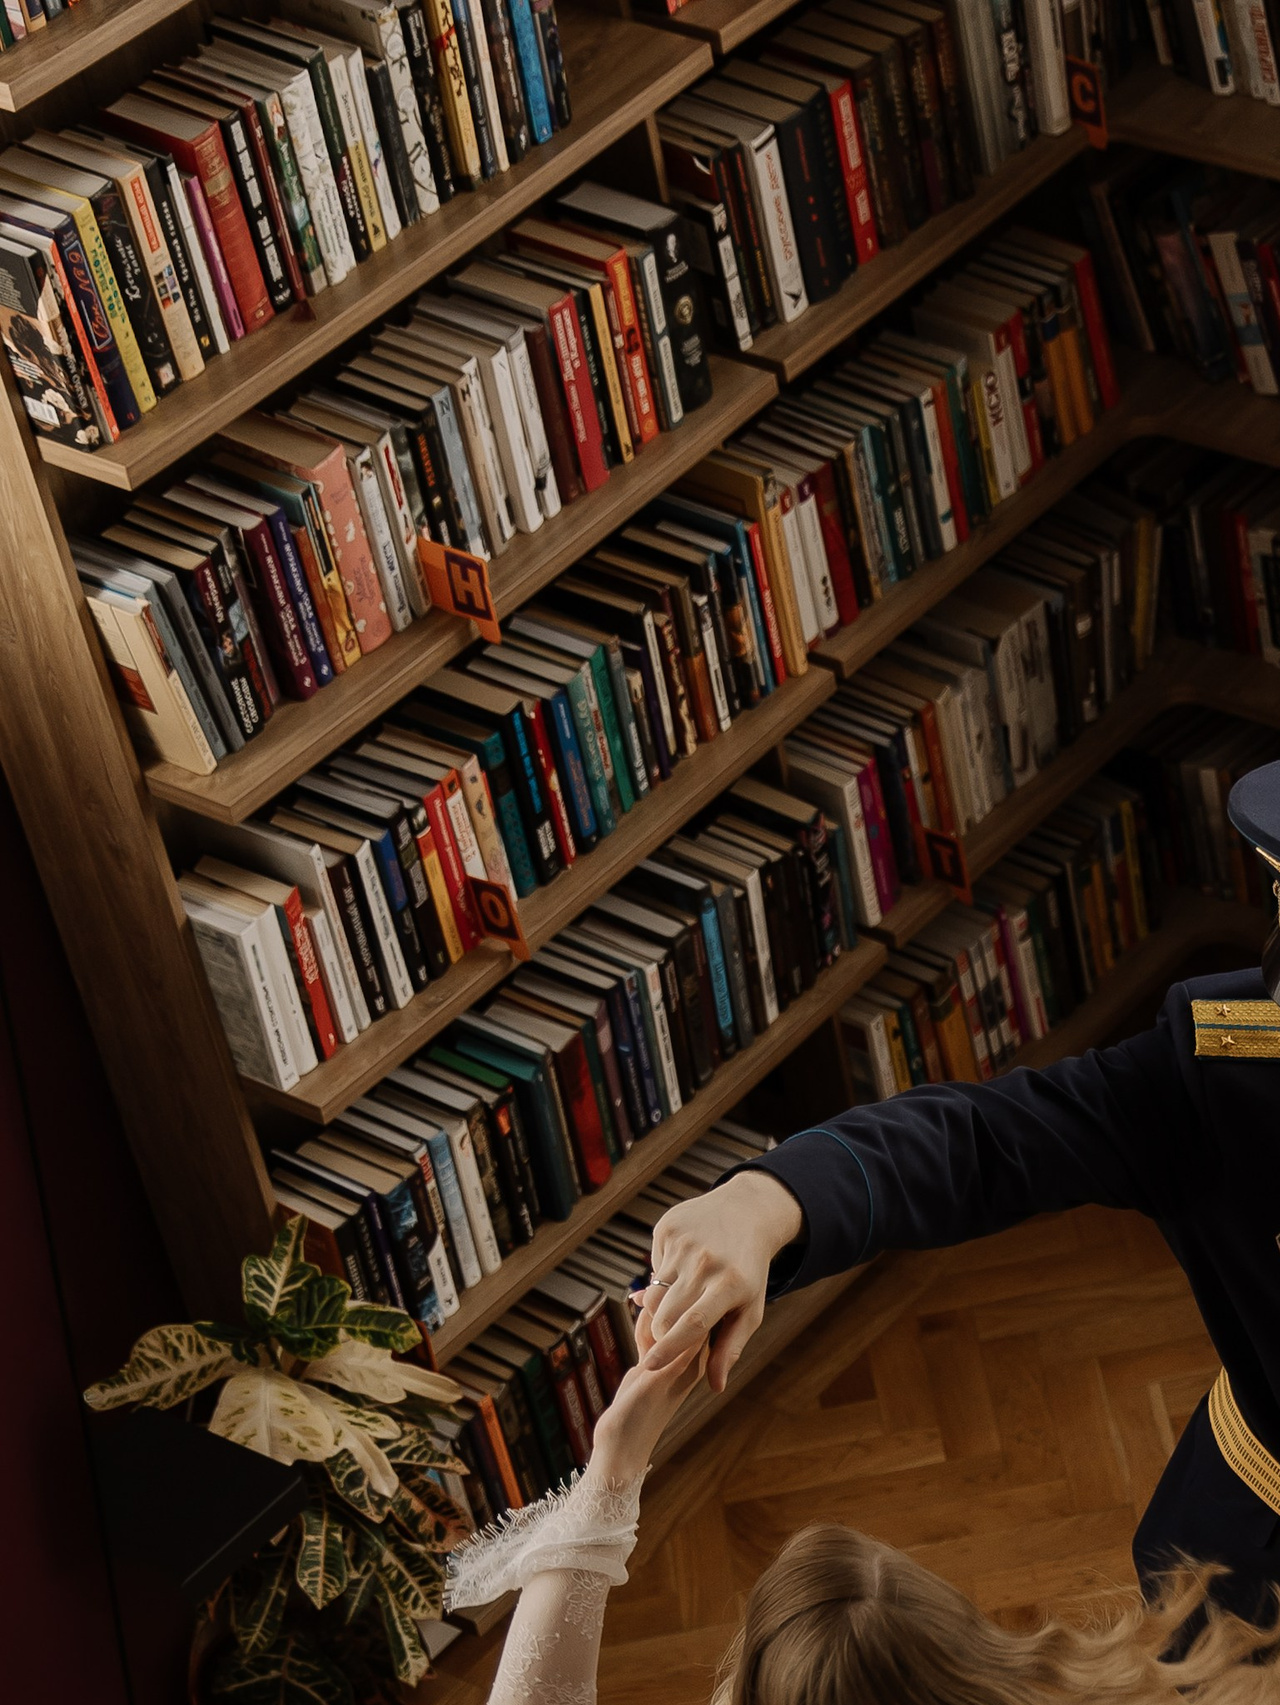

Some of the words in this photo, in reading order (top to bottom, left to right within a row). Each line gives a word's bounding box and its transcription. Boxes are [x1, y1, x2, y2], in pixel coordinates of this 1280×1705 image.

[1072, 72, 1096, 113] С
[449, 561, 486, 611] Н
[480, 890, 509, 928] О
